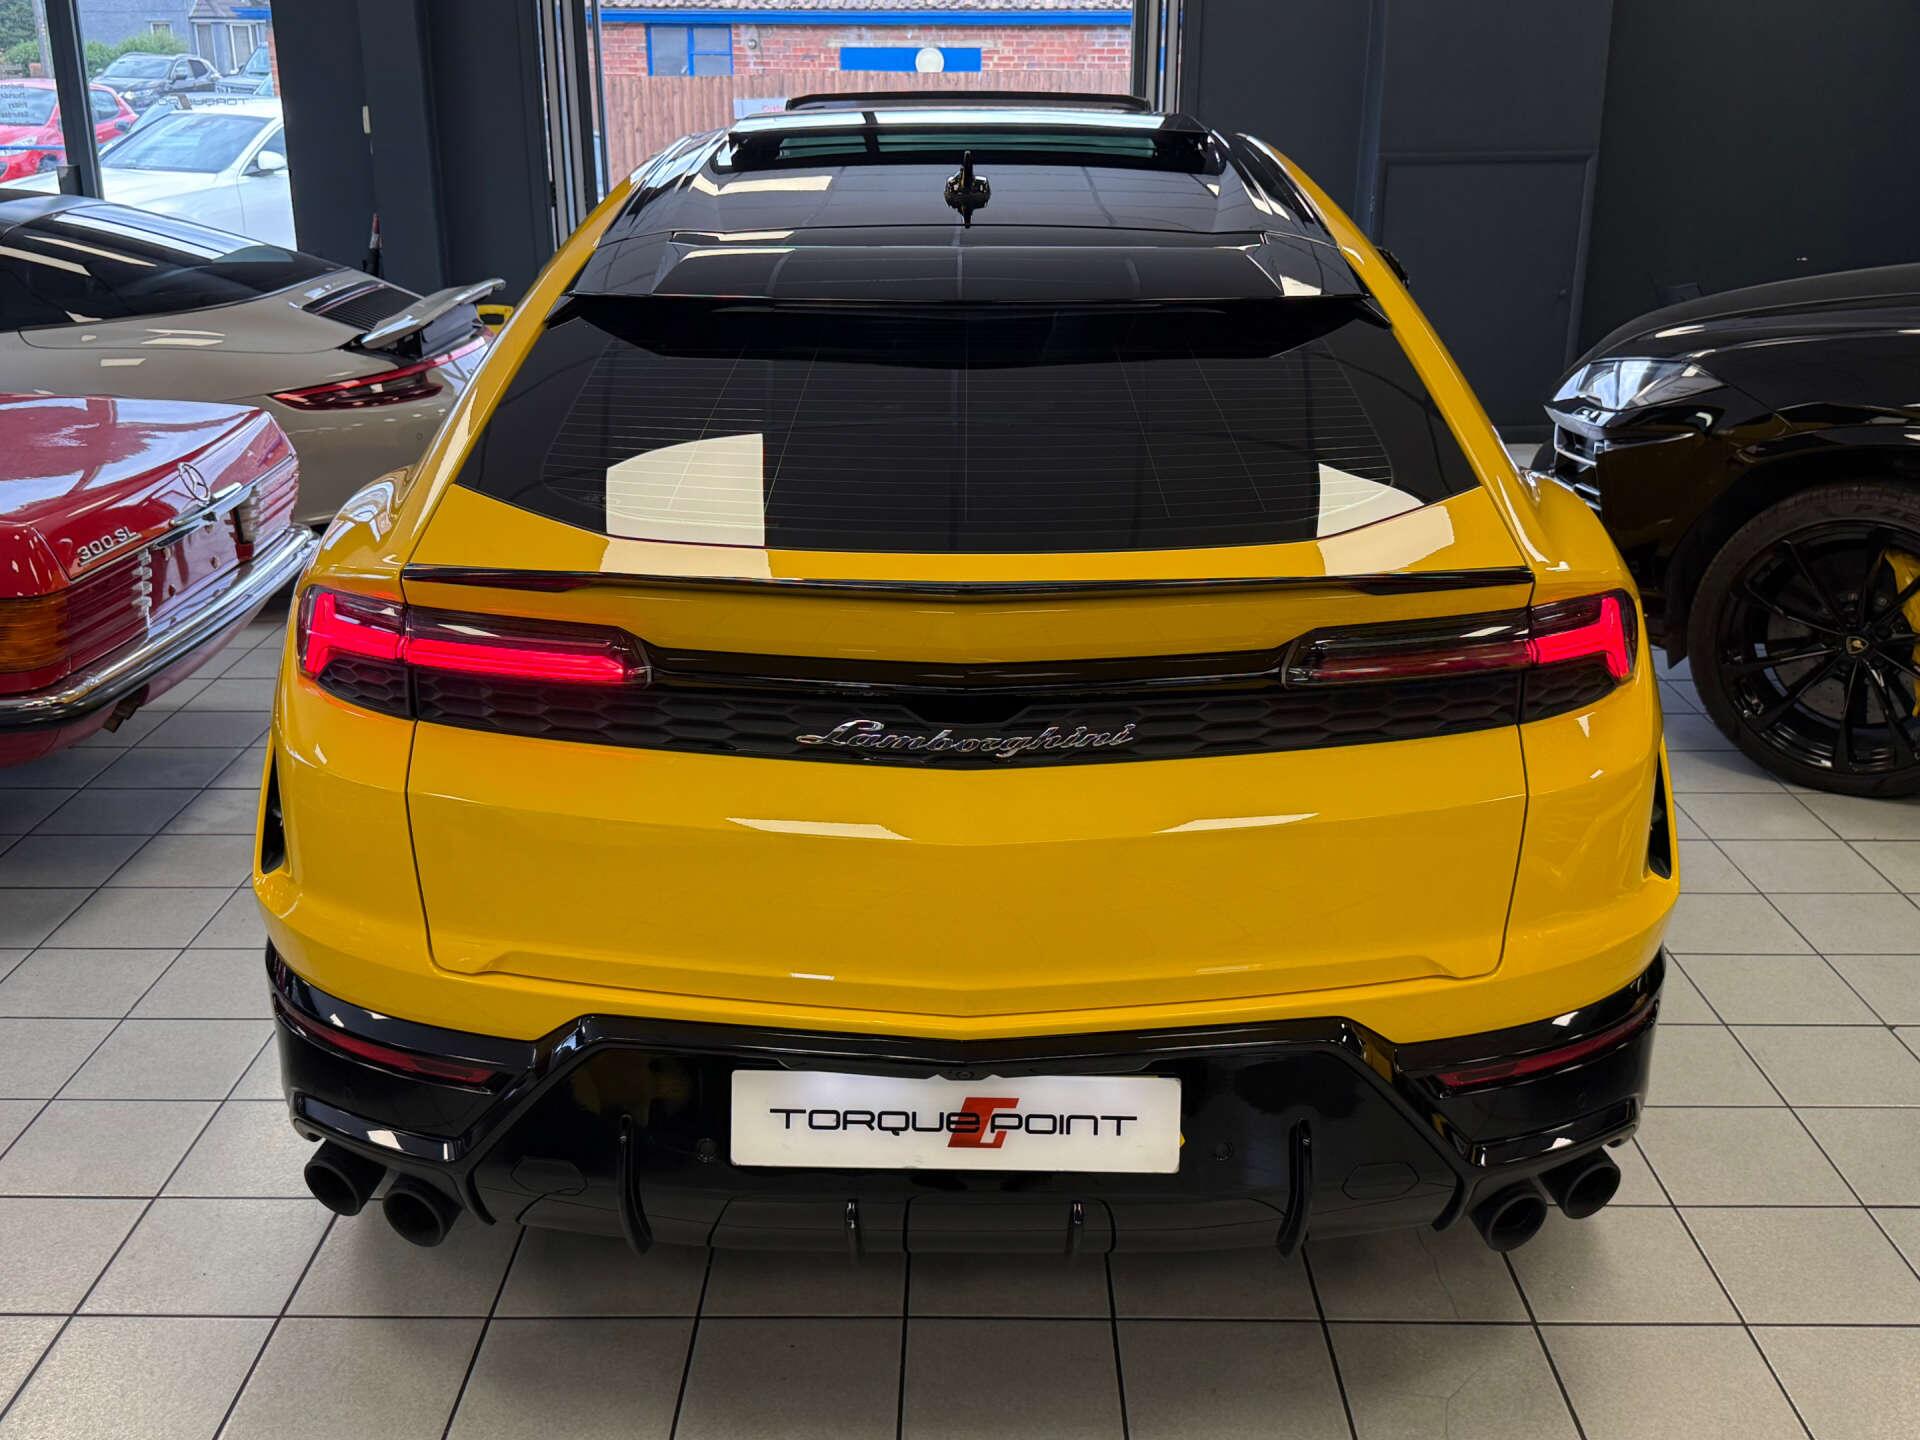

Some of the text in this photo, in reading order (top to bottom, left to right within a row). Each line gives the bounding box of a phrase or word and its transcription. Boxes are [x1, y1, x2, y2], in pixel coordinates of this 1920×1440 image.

[77, 526, 137, 561] 300 SL
[796, 719, 1137, 758] Lamborghini
[769, 1107, 1138, 1137] TORQUE POINT
